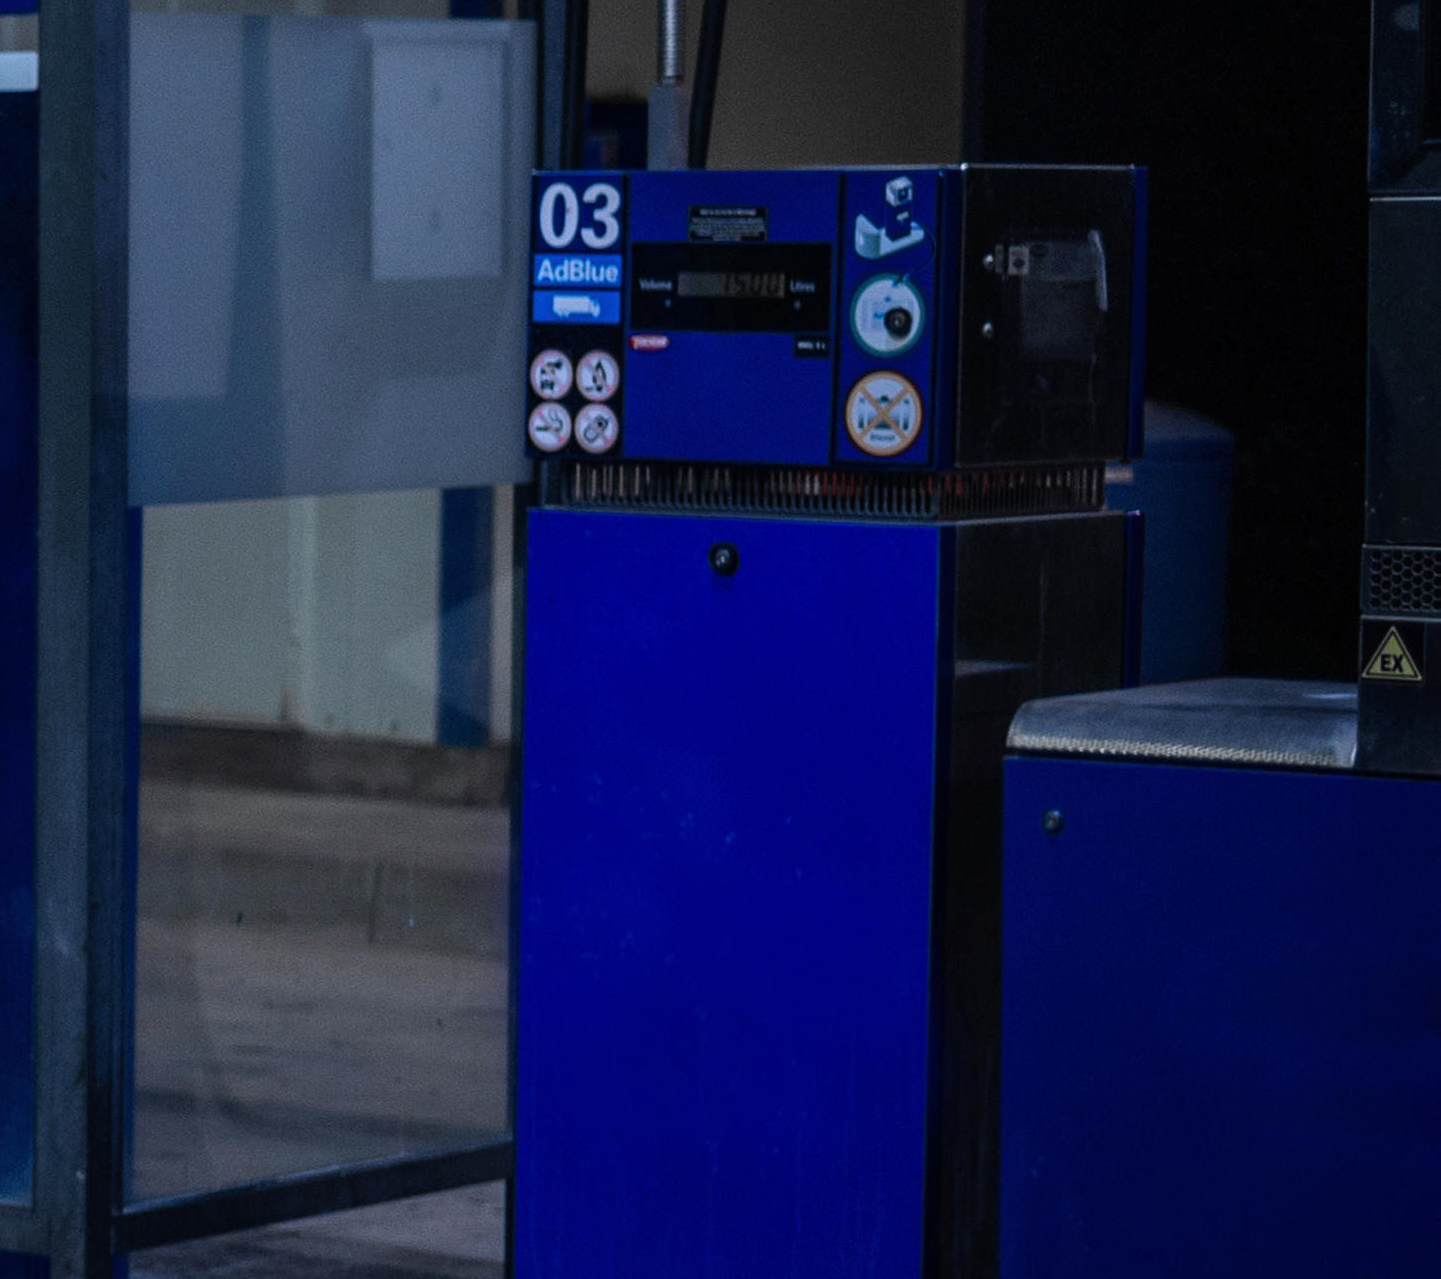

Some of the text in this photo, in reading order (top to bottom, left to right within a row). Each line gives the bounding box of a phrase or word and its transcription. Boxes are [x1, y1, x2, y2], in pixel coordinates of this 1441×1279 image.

[539, 181, 621, 249] 03
[537, 258, 619, 284] AdBlue
[1380, 653, 1404, 673] EX
